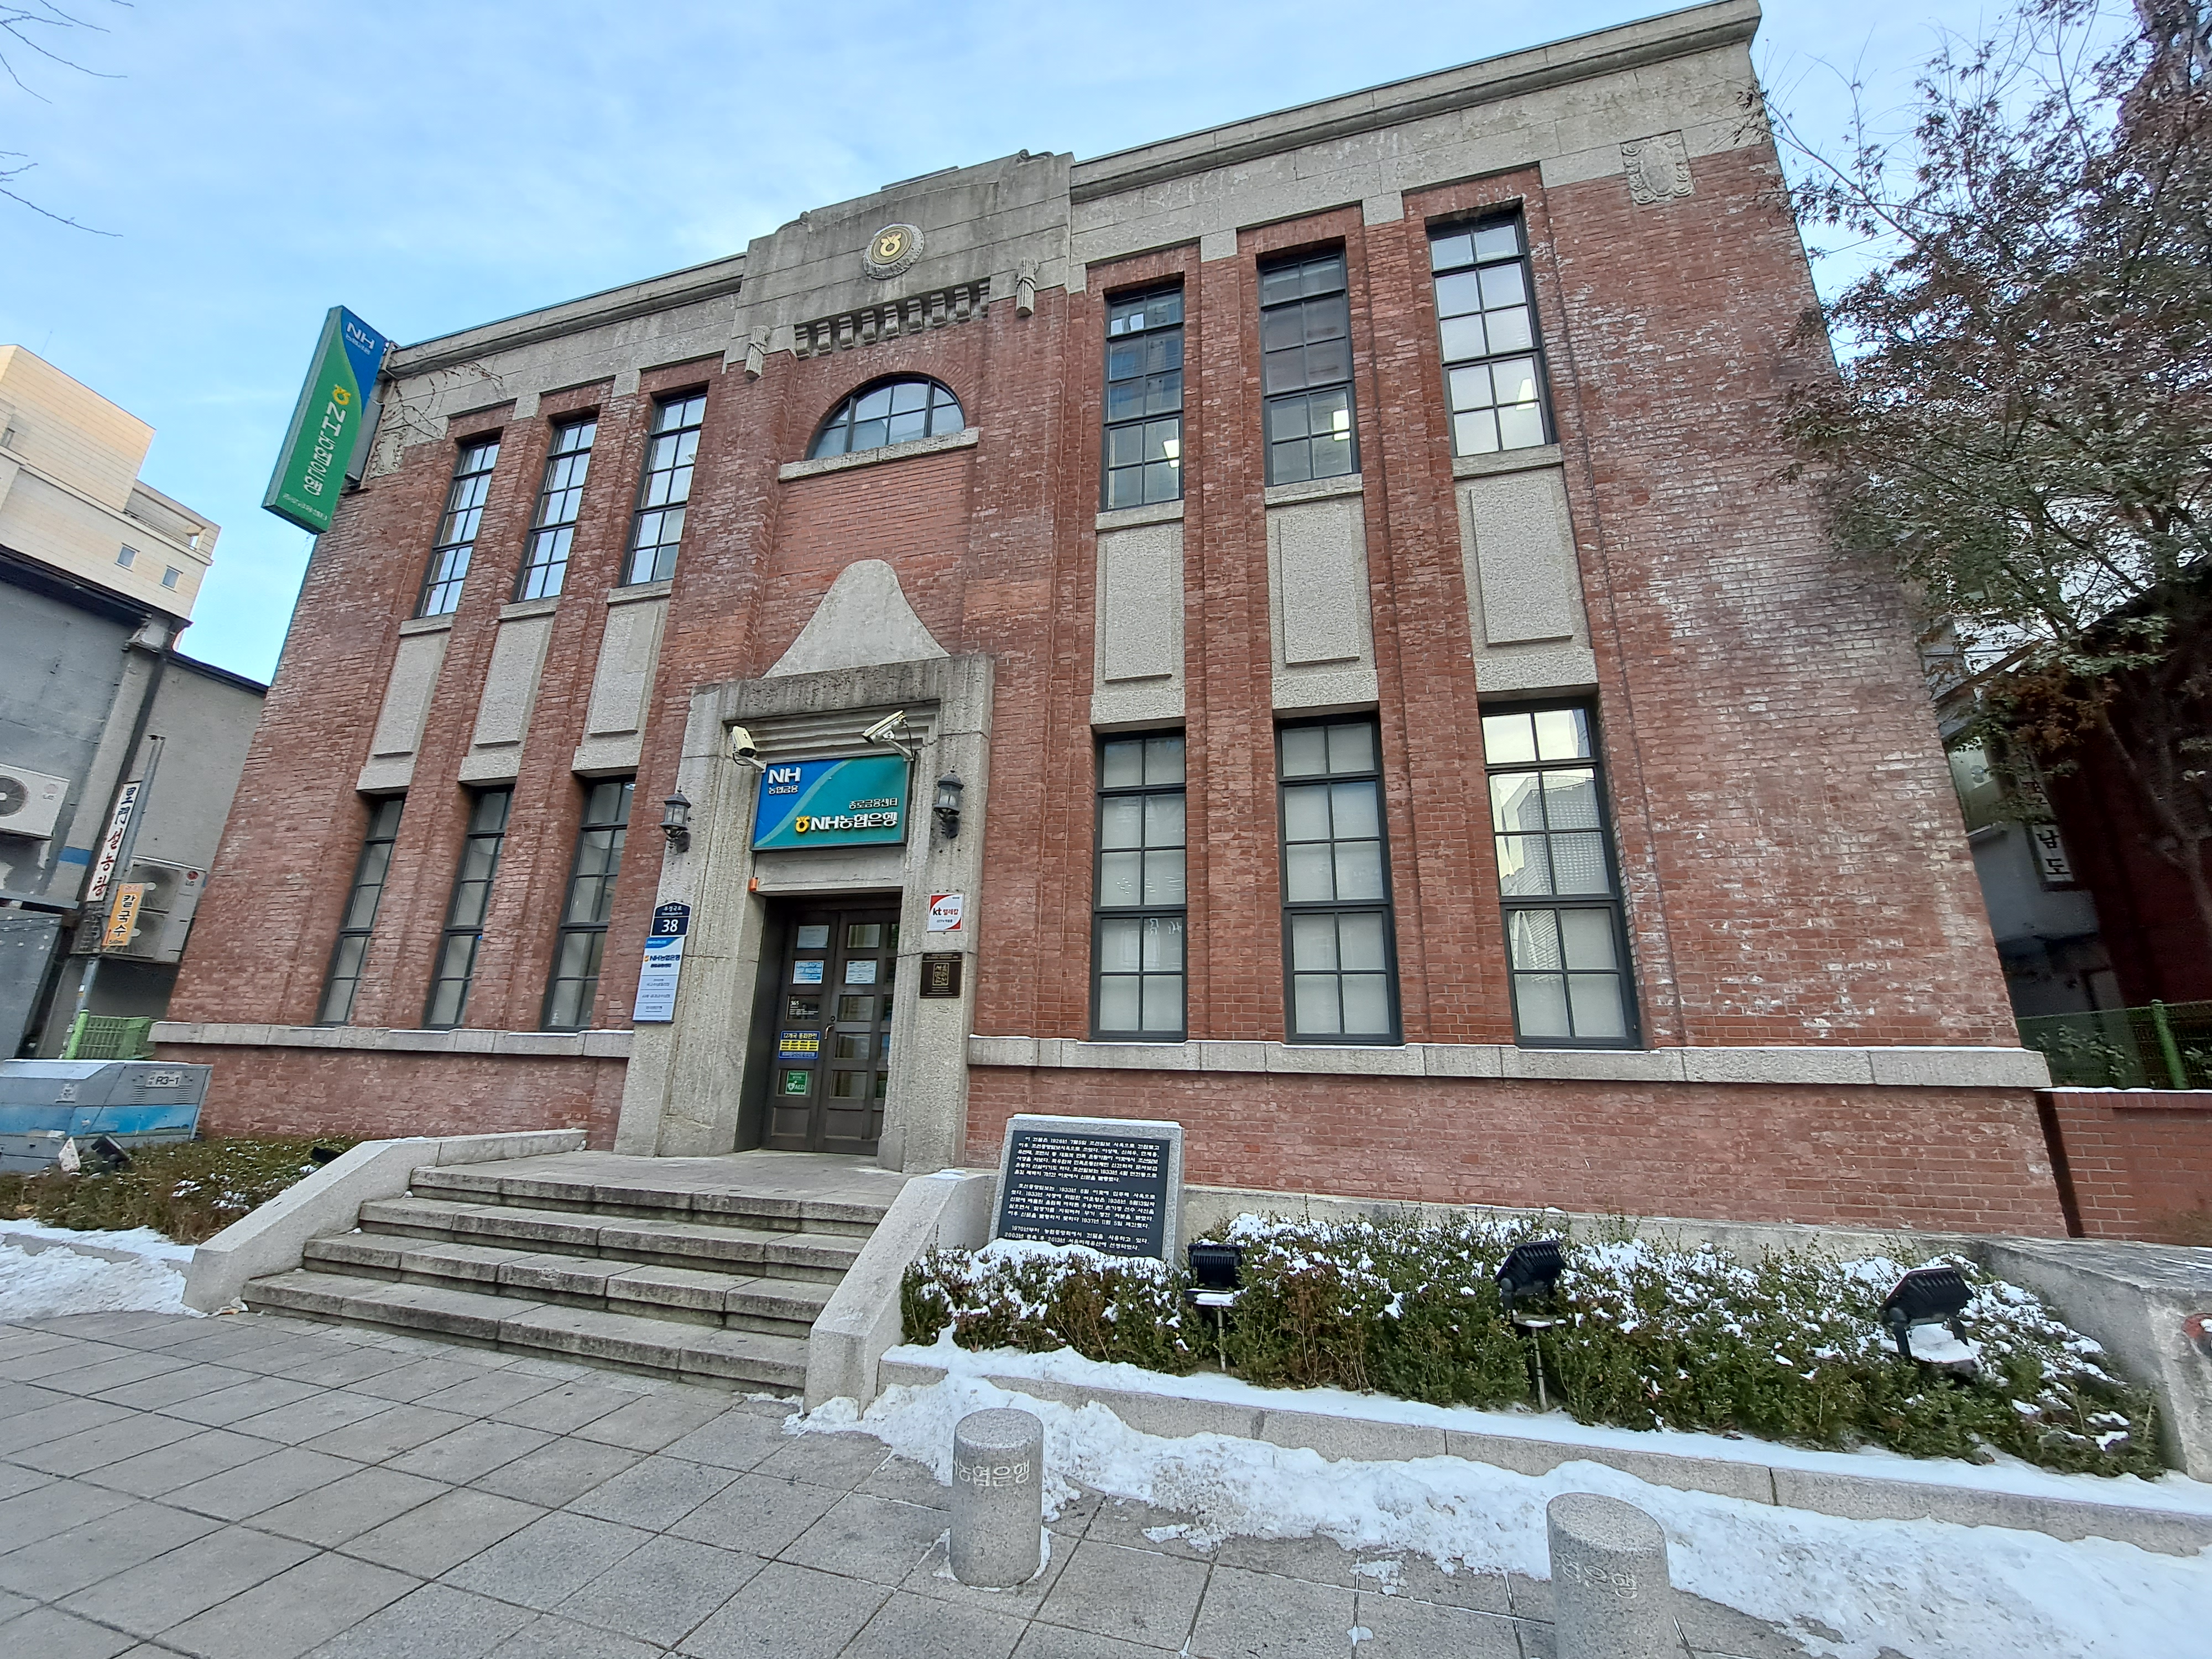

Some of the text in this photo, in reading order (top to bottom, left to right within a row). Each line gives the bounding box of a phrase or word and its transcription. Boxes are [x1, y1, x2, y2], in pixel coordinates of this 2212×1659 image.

[346, 321, 375, 349] NH
[768, 767, 801, 784] NH
[768, 785, 799, 795] 농협금융
[849, 797, 898, 810] 종로금융센터
[811, 812, 899, 831] NH농협은행
[113, 894, 137, 937] 칼국수
[932, 907, 942, 916] kt
[661, 919, 679, 932] 38
